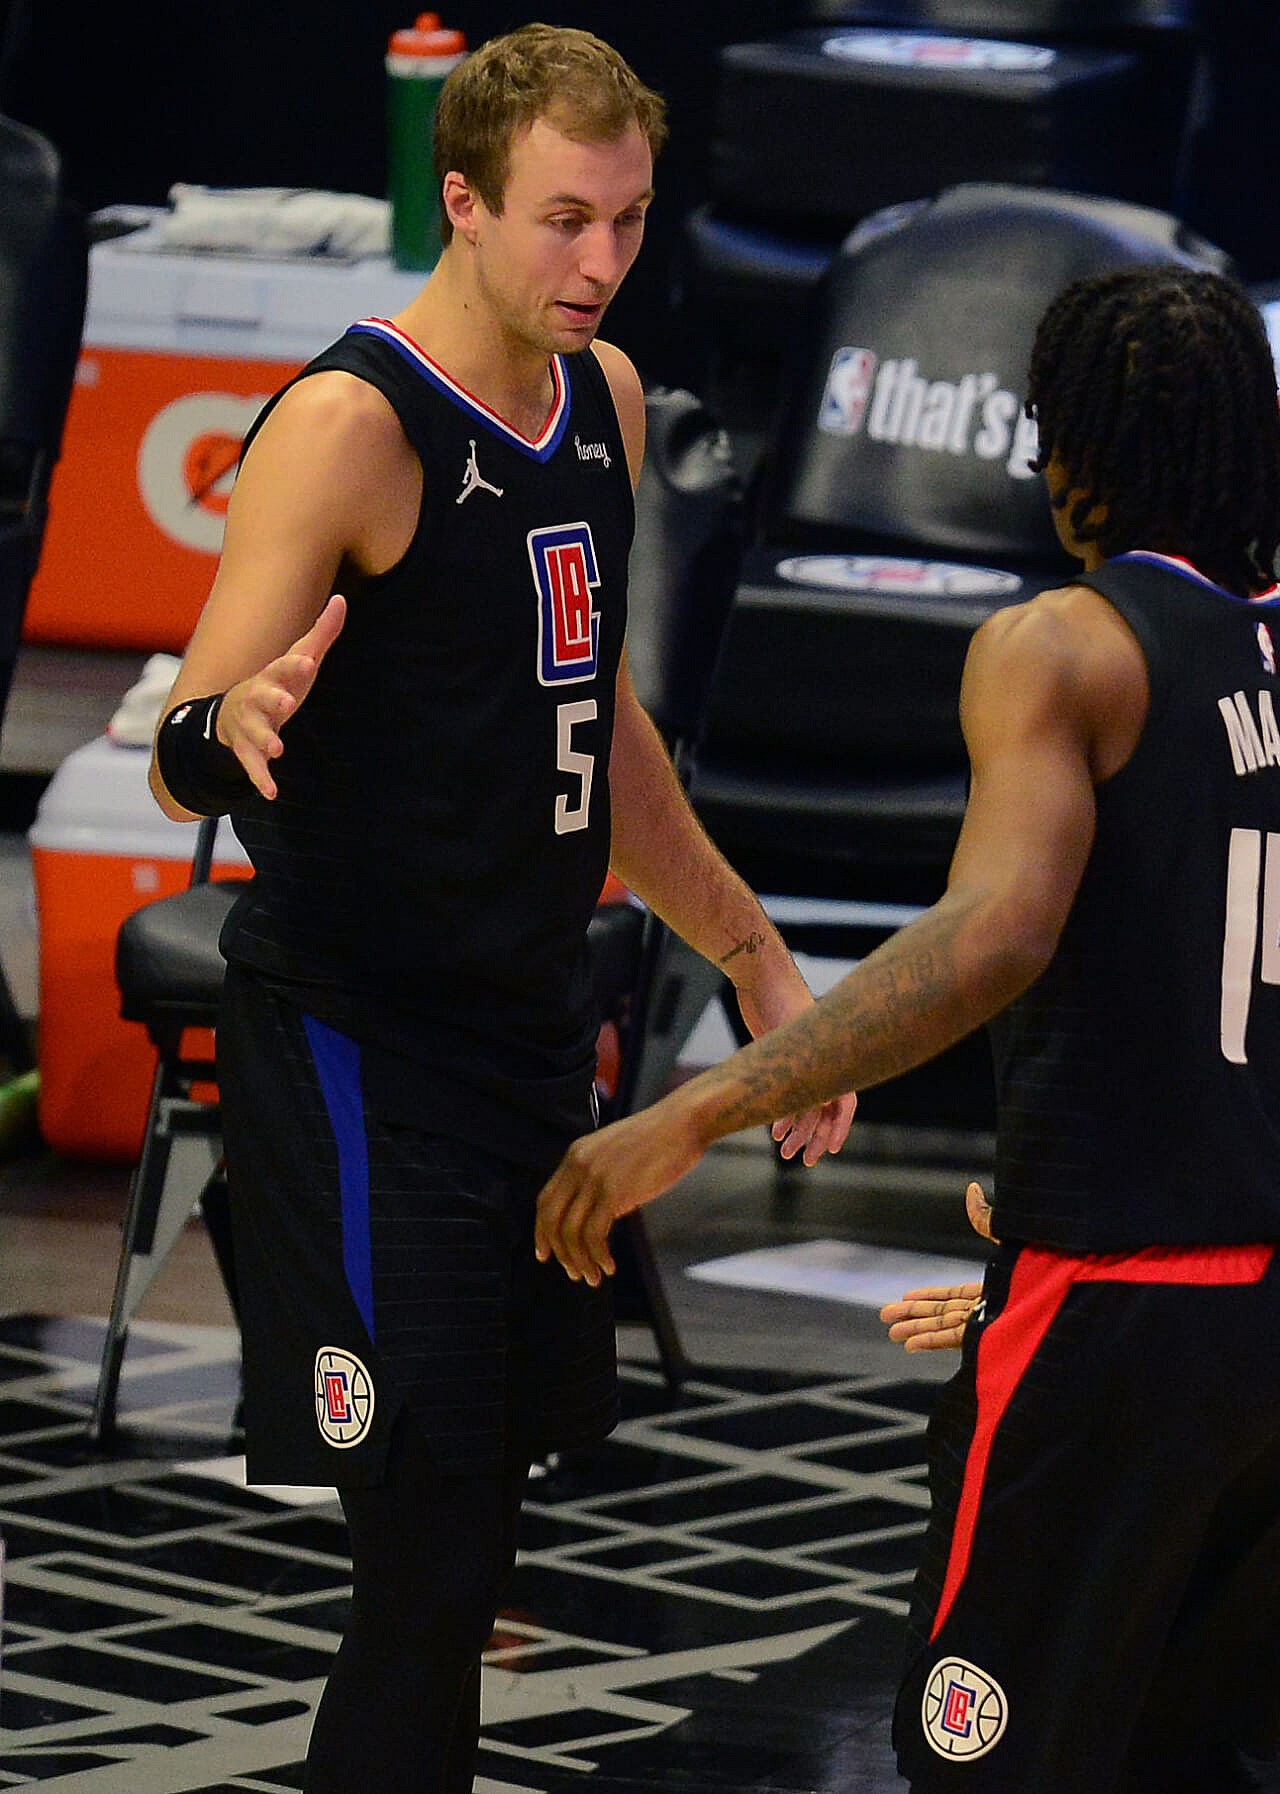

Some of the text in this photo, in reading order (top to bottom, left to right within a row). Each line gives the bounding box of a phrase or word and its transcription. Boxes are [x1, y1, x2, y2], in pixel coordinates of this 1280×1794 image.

[574, 434, 612, 469] honey
[867, 357, 1017, 459] that's
[555, 700, 597, 834] 5
